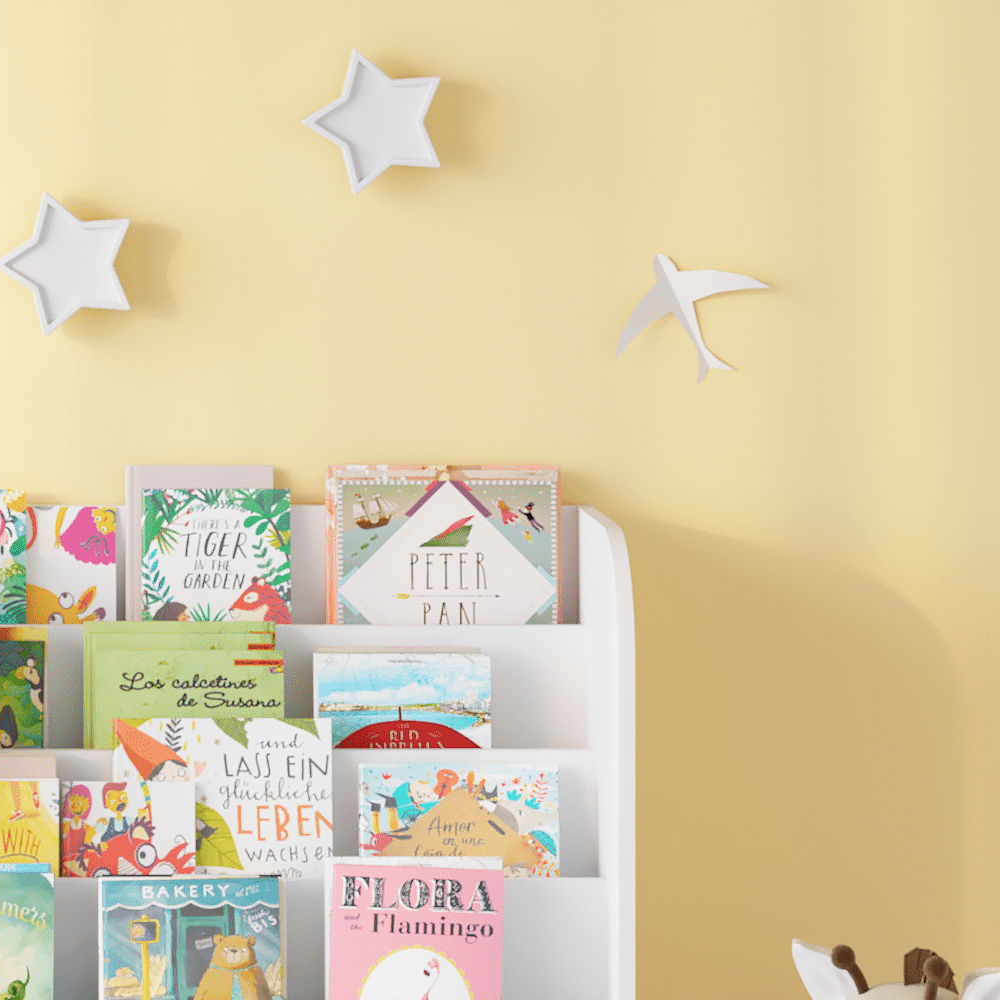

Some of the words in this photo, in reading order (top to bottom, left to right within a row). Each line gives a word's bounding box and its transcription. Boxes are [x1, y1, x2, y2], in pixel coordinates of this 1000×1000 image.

[180, 531, 248, 559] TIGER
[193, 560, 204, 571] IN
[212, 560, 232, 571] THE
[409, 552, 487, 590] PETER
[183, 573, 246, 589] GARDEN
[422, 602, 476, 625] PAN
[119, 671, 165, 691] Los
[171, 673, 258, 690] calcetines
[177, 693, 199, 708] de
[204, 691, 281, 709] Susana
[255, 733, 304, 749] und
[223, 752, 271, 779] LASS
[427, 815, 476, 837] Amor
[1, 827, 41, 858] WITH
[141, 883, 230, 899] BAKERY
[339, 875, 498, 914] FLORA
[373, 913, 494, 944] Flamingo
